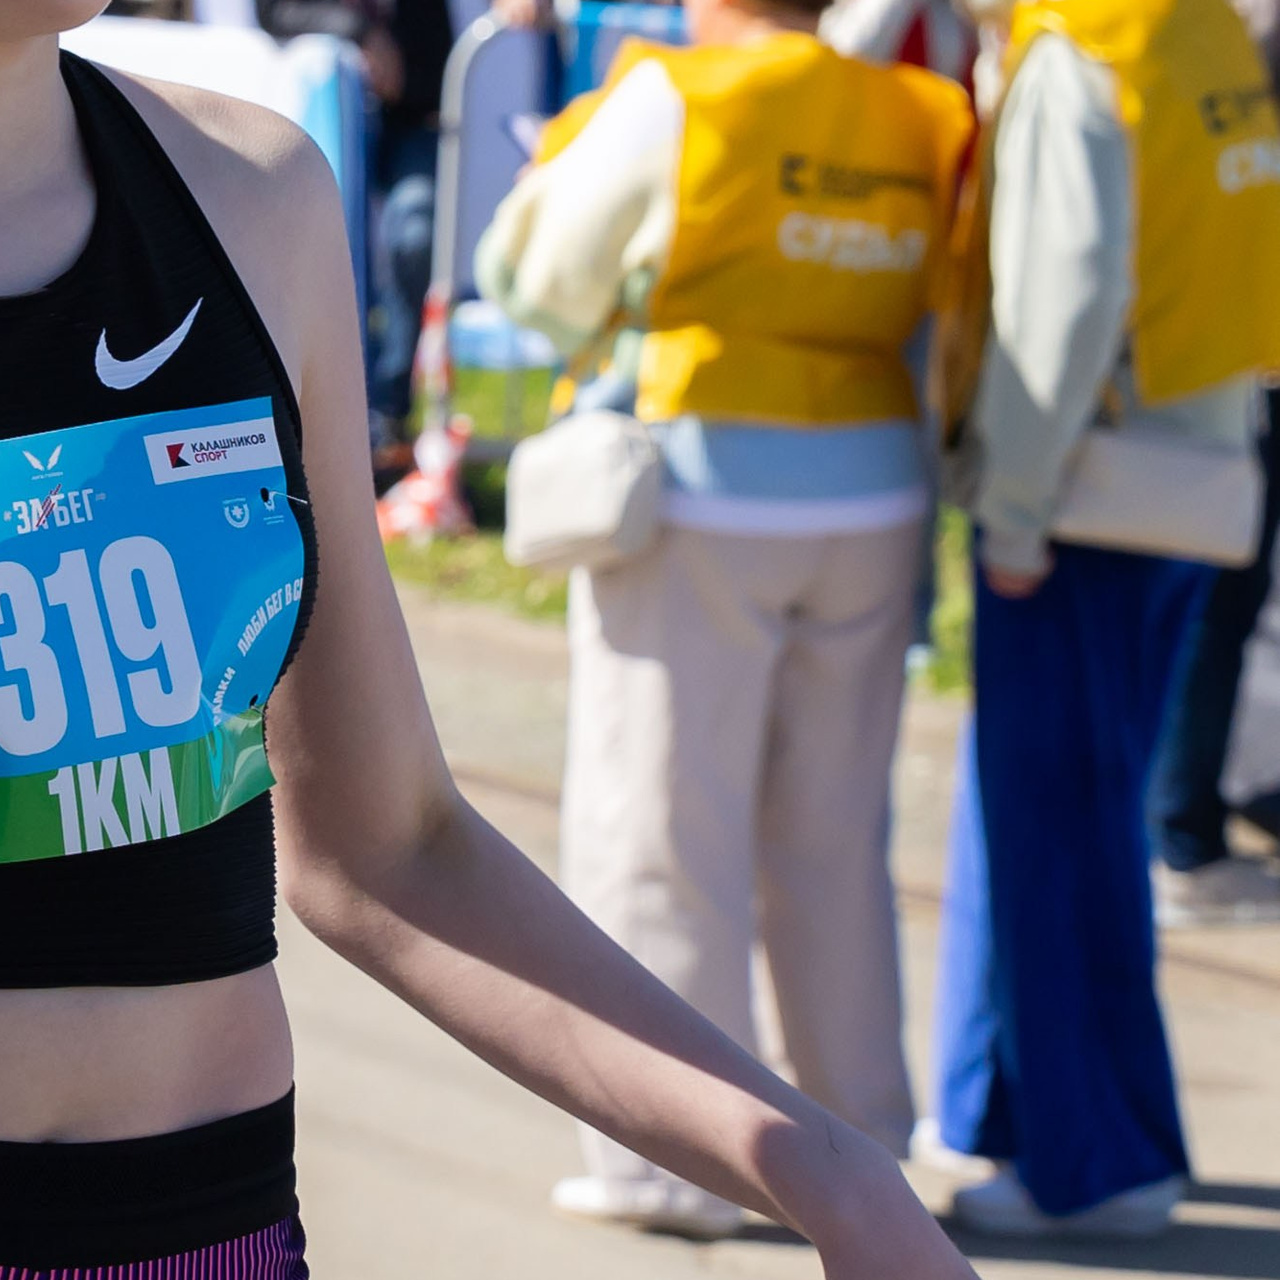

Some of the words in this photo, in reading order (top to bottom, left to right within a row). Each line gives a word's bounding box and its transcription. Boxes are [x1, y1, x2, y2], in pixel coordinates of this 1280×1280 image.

[191, 433, 267, 453] КАЛАШНИКОВ
[194, 450, 228, 463] СПОРТ
[237, 605, 268, 657] ЛЮБИ
[265, 588, 284, 621] БЕГ
